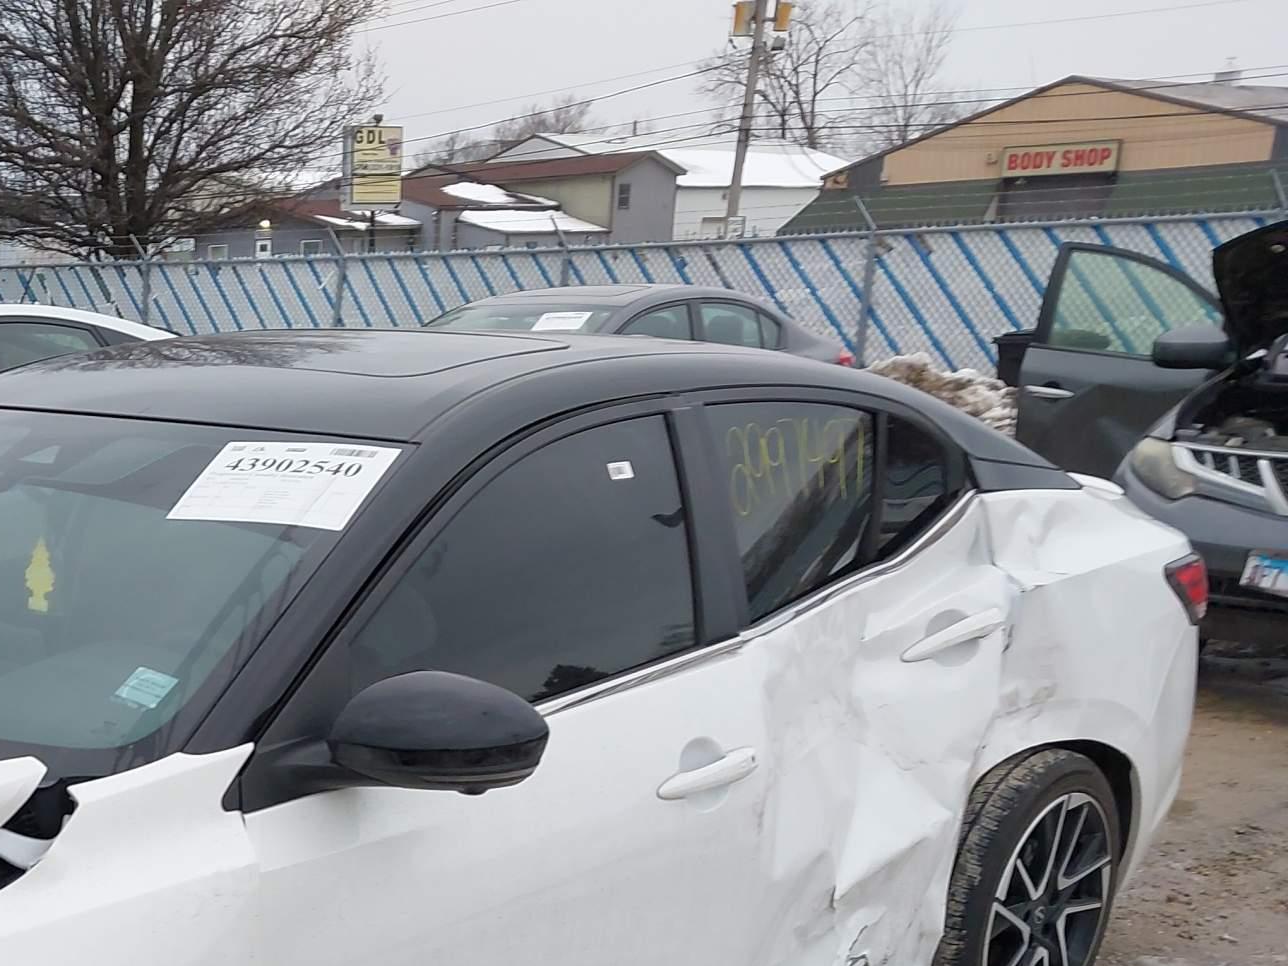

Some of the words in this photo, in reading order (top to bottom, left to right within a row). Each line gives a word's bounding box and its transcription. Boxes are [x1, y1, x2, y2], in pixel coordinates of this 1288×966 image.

[355, 129, 386, 145] GDL
[1007, 150, 1057, 171] BODY
[1061, 147, 1112, 168] SHOP
[225, 457, 363, 478] 43902540
